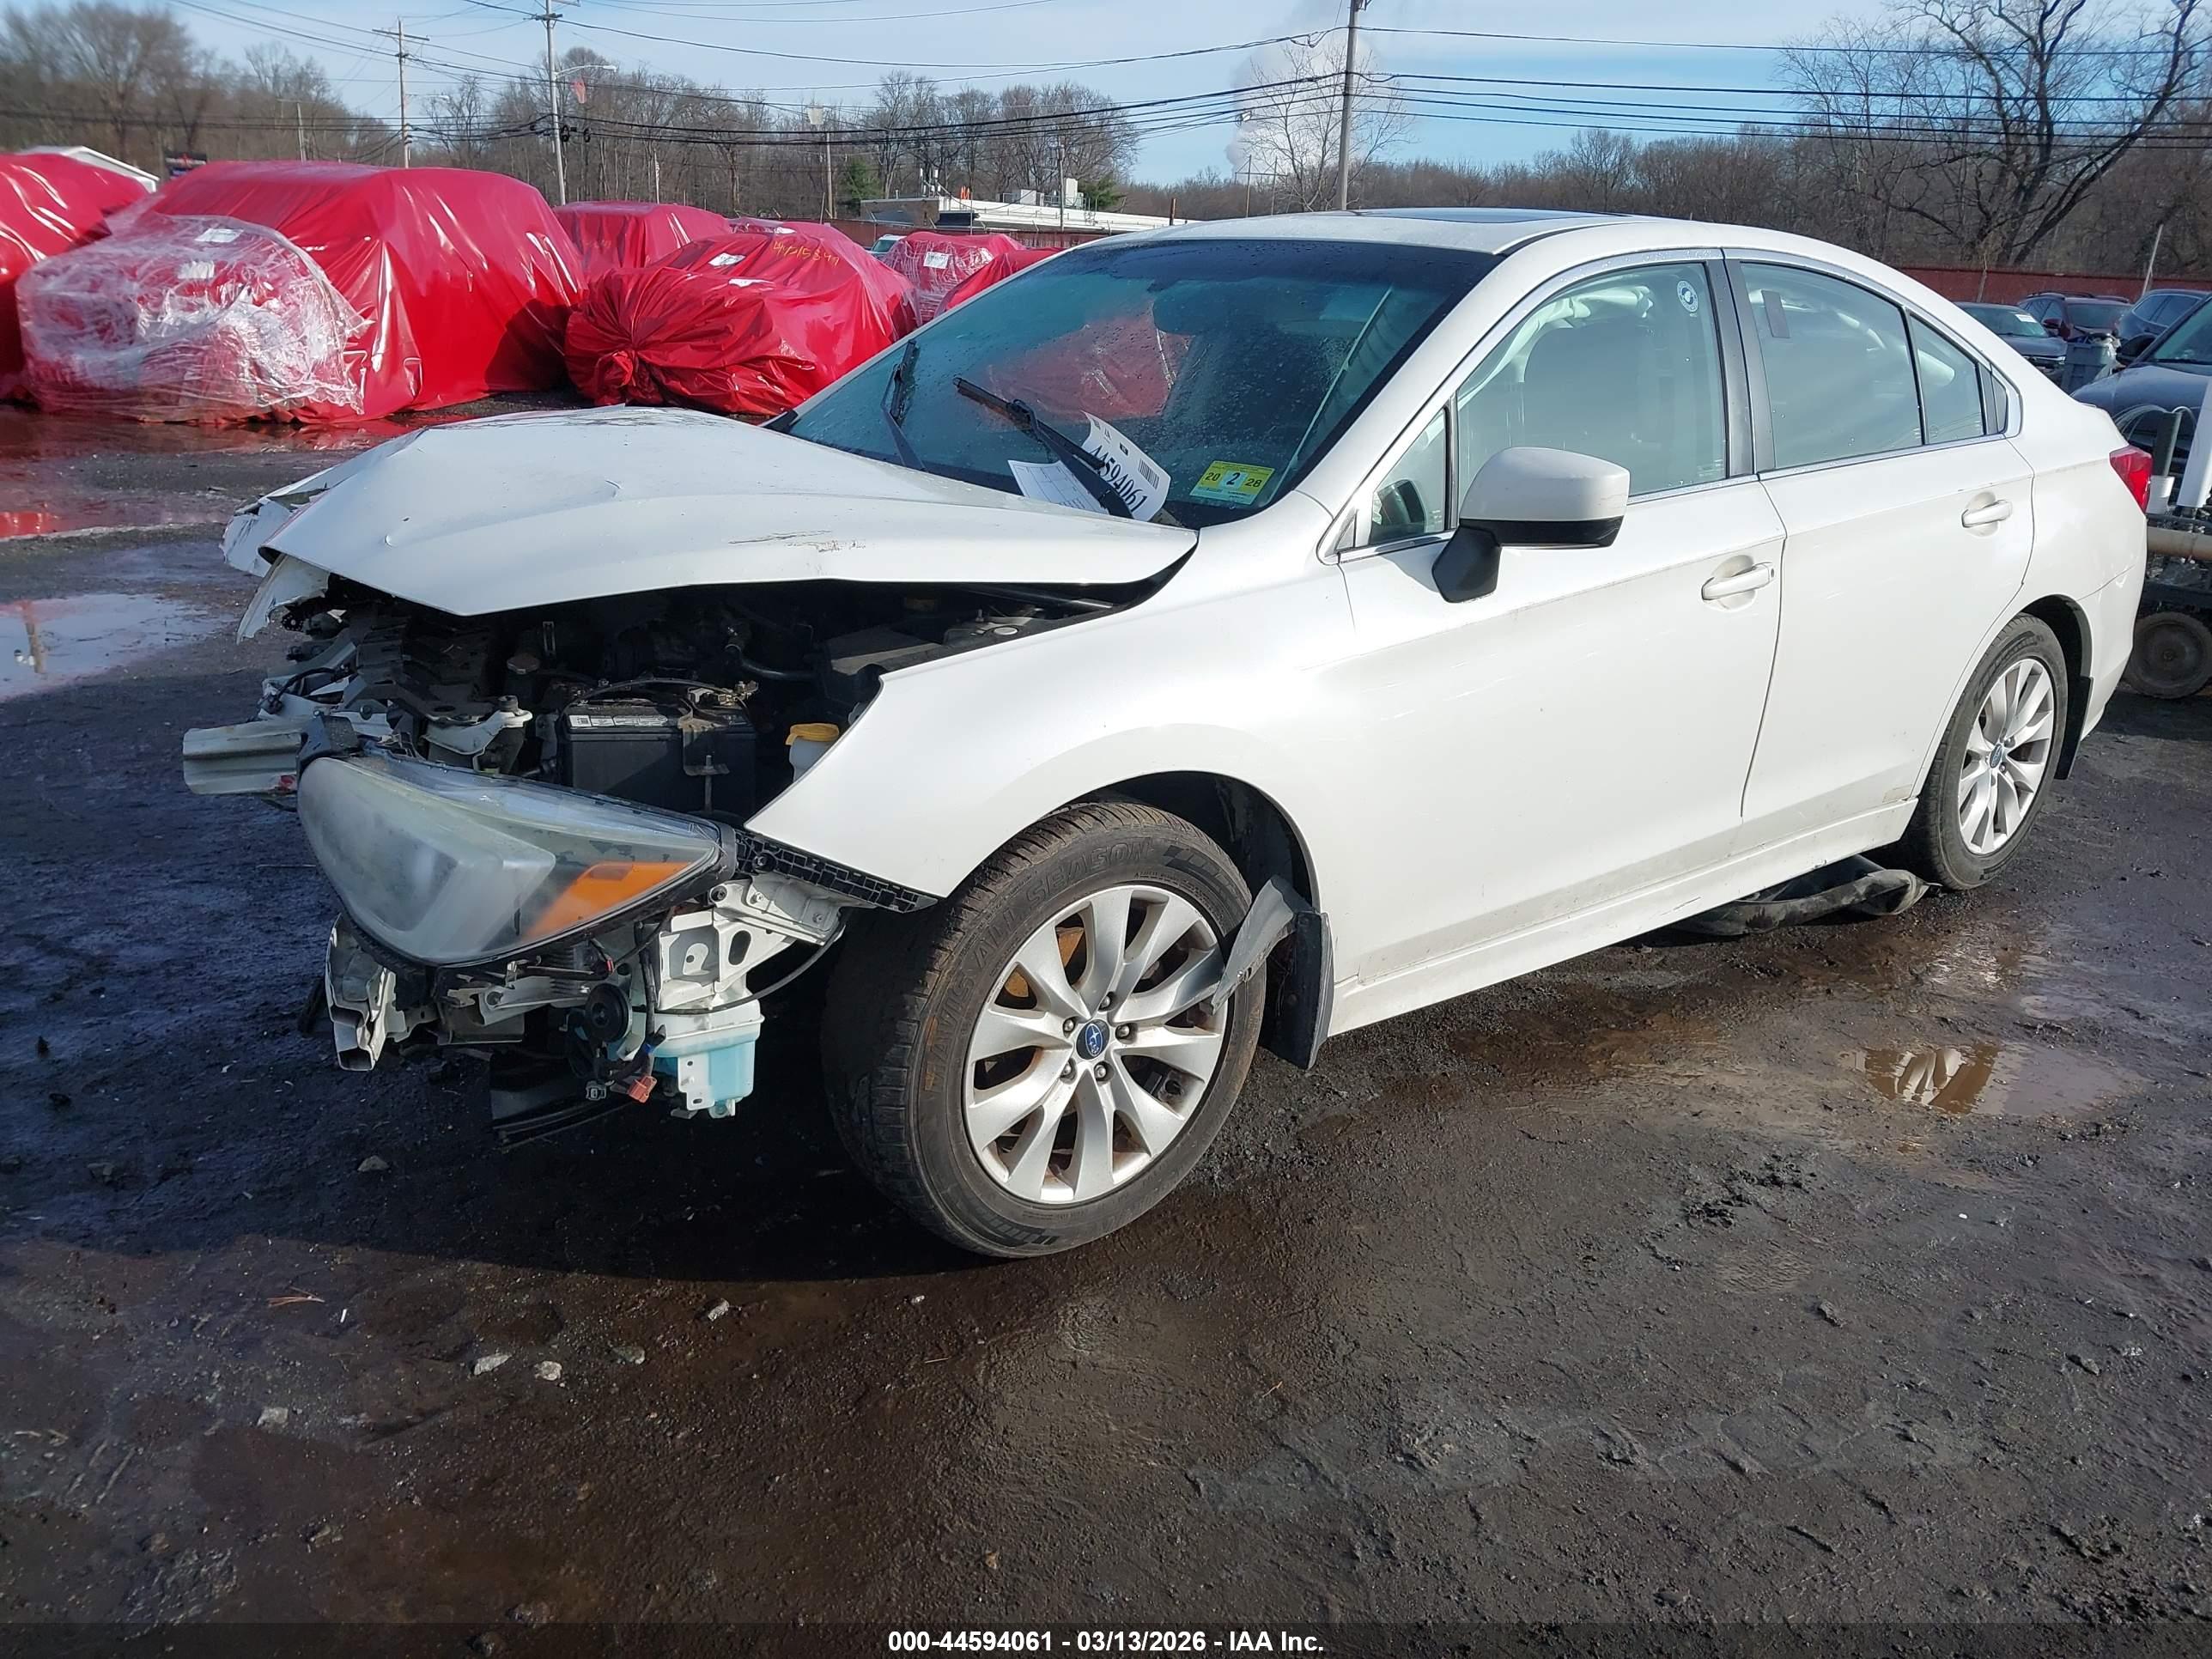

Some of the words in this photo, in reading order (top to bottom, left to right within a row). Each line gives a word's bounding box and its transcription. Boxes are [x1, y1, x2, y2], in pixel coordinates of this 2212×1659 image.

[1205, 472, 1220, 481] 20
[1226, 472, 1241, 485] 2
[1245, 478, 1262, 487] 28
[1025, 840, 1152, 903] SEASON
